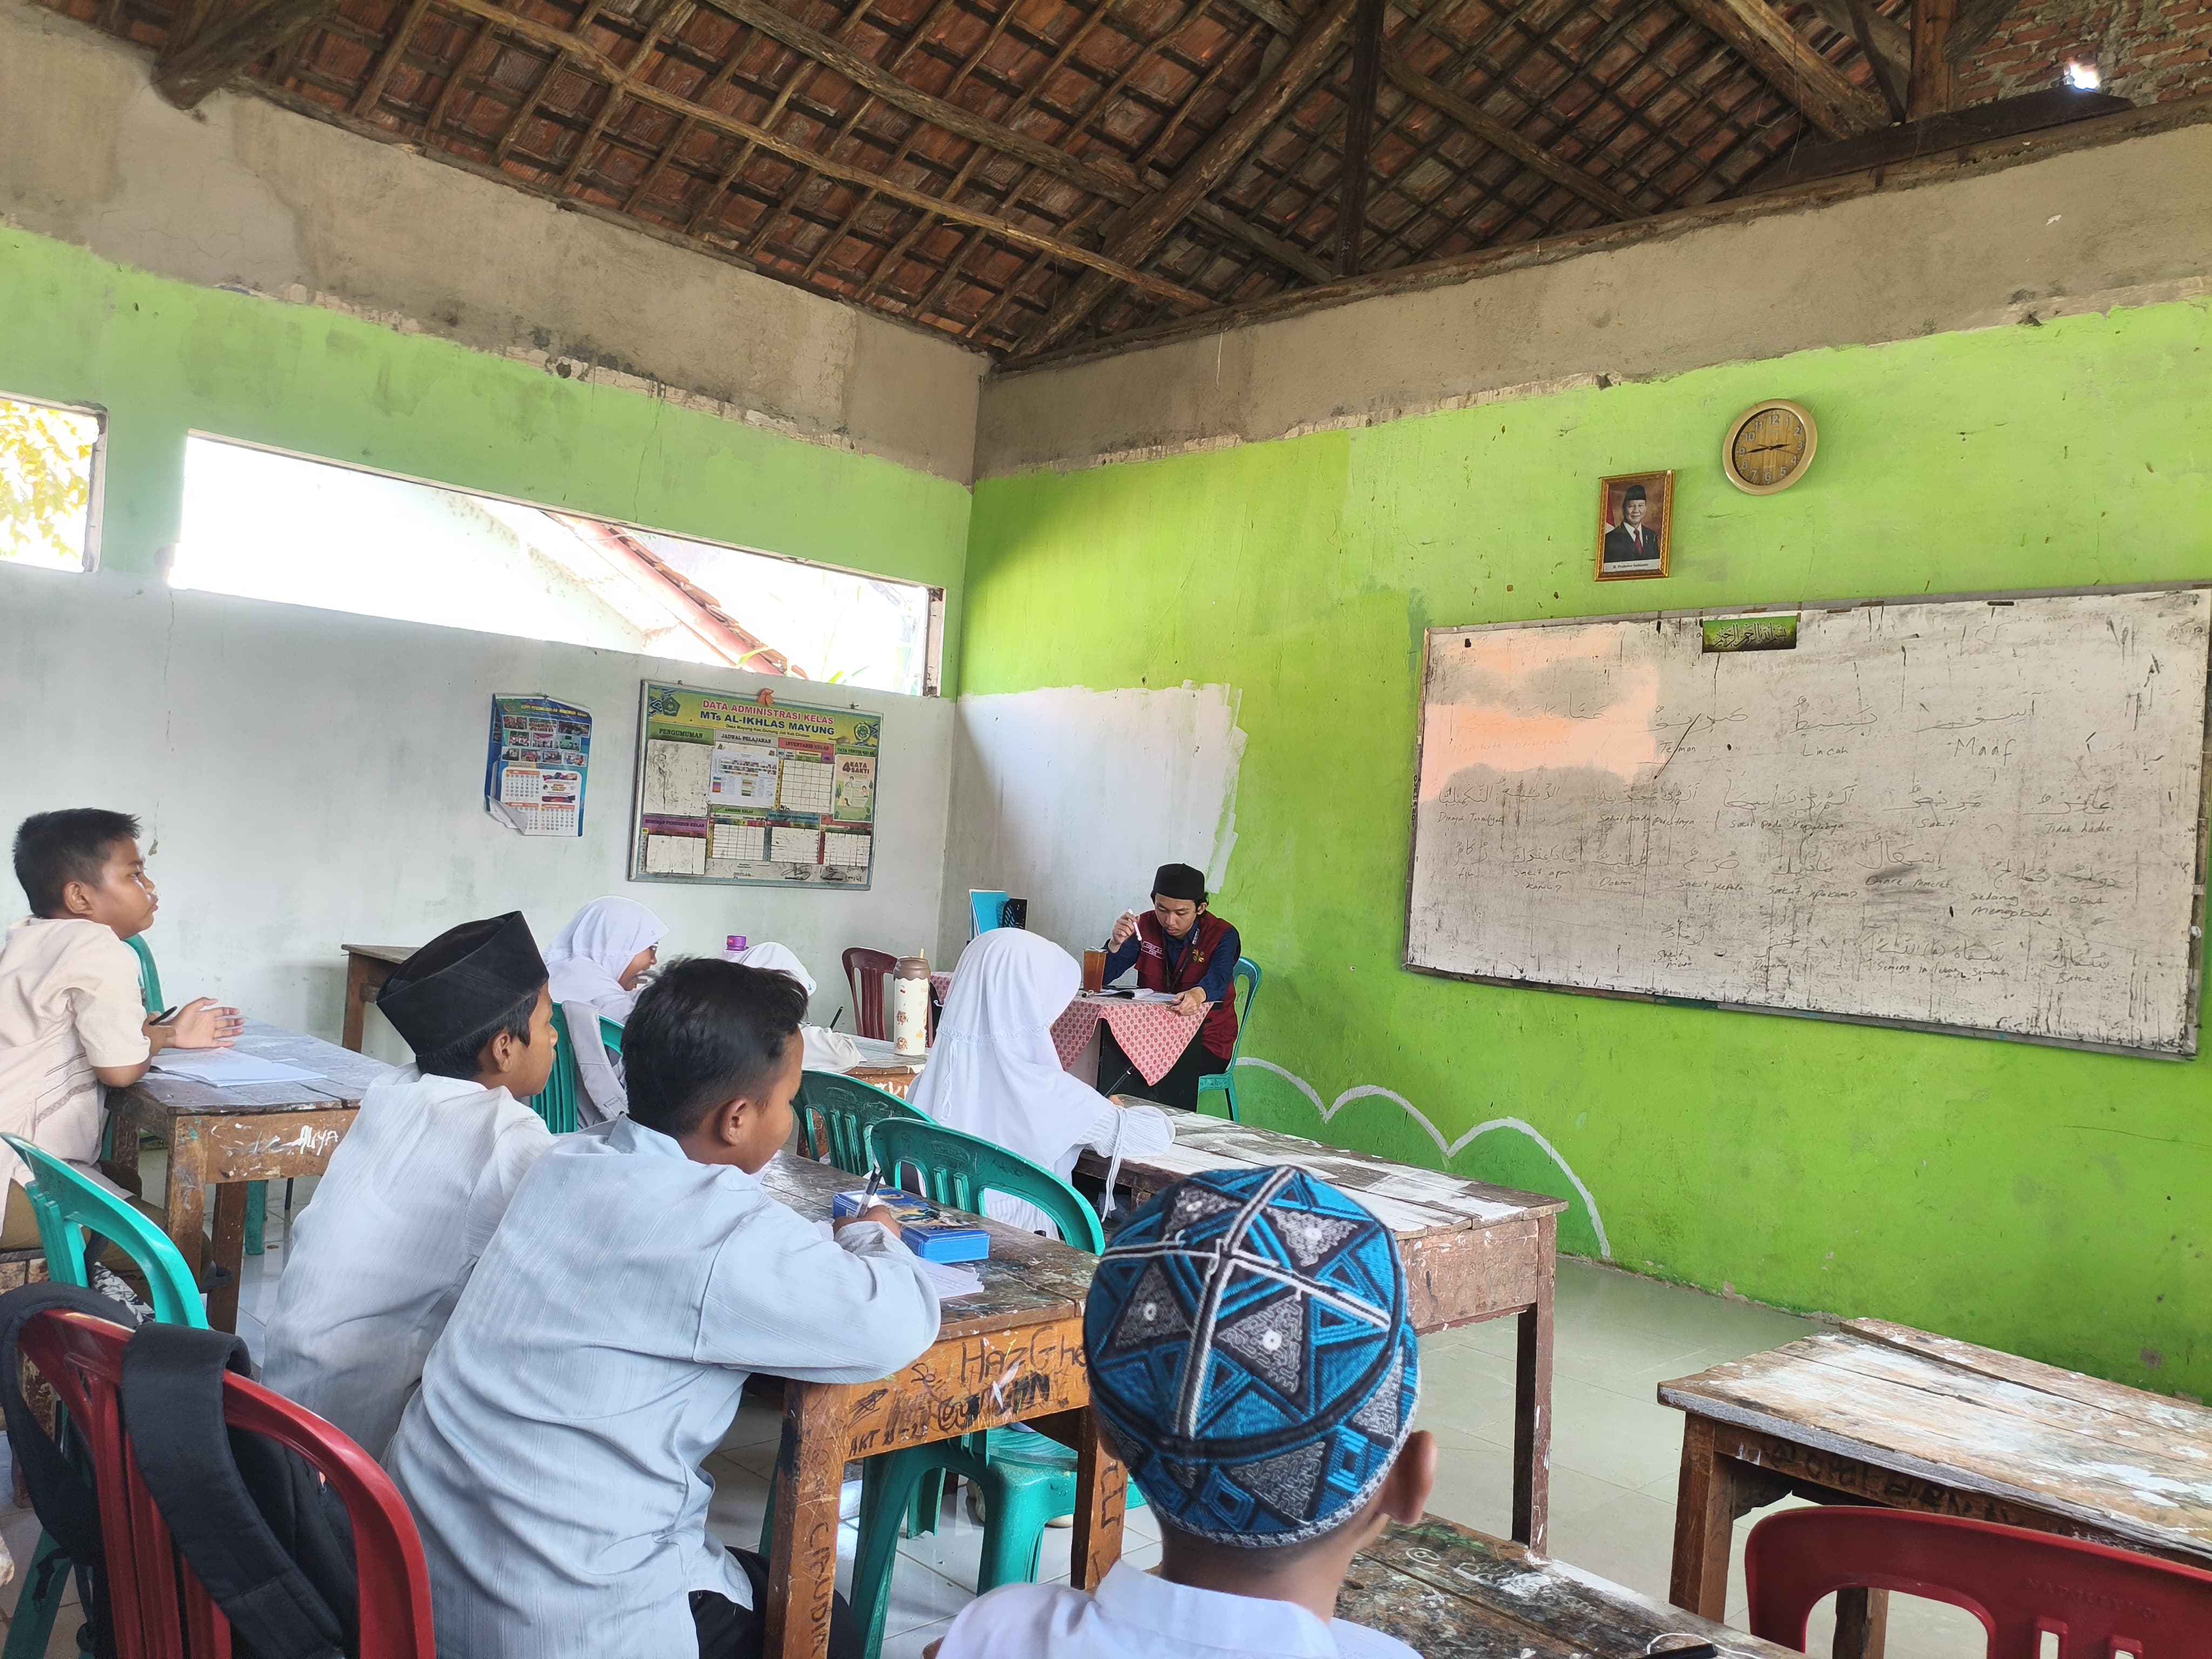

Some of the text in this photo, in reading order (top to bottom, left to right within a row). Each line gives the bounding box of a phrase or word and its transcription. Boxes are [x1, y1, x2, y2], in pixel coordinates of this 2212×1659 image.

[1768, 414, 1779, 424] 12
[1786, 416, 1790, 427] 1
[1755, 420, 1764, 430] 11
[1793, 426, 1801, 436] 2
[1745, 432, 1756, 441] 10
[1797, 440, 1804, 450] 3
[1739, 447, 1746, 456] 9
[1791, 455, 1797, 465] 4
[1742, 461, 1748, 470] 8
[1751, 470, 1758, 482] 7
[1765, 472, 1771, 481] 6
[1780, 467, 1786, 476] 5
[703, 700, 834, 725] DATA ADMINISTRASI KELAS
[700, 711, 835, 736] MTs AL-IKHLAS MAYUNG
[659, 729, 703, 738] PENGUMUMAN
[1954, 736, 2017, 767] Maaf
[843, 761, 851, 773] 4
